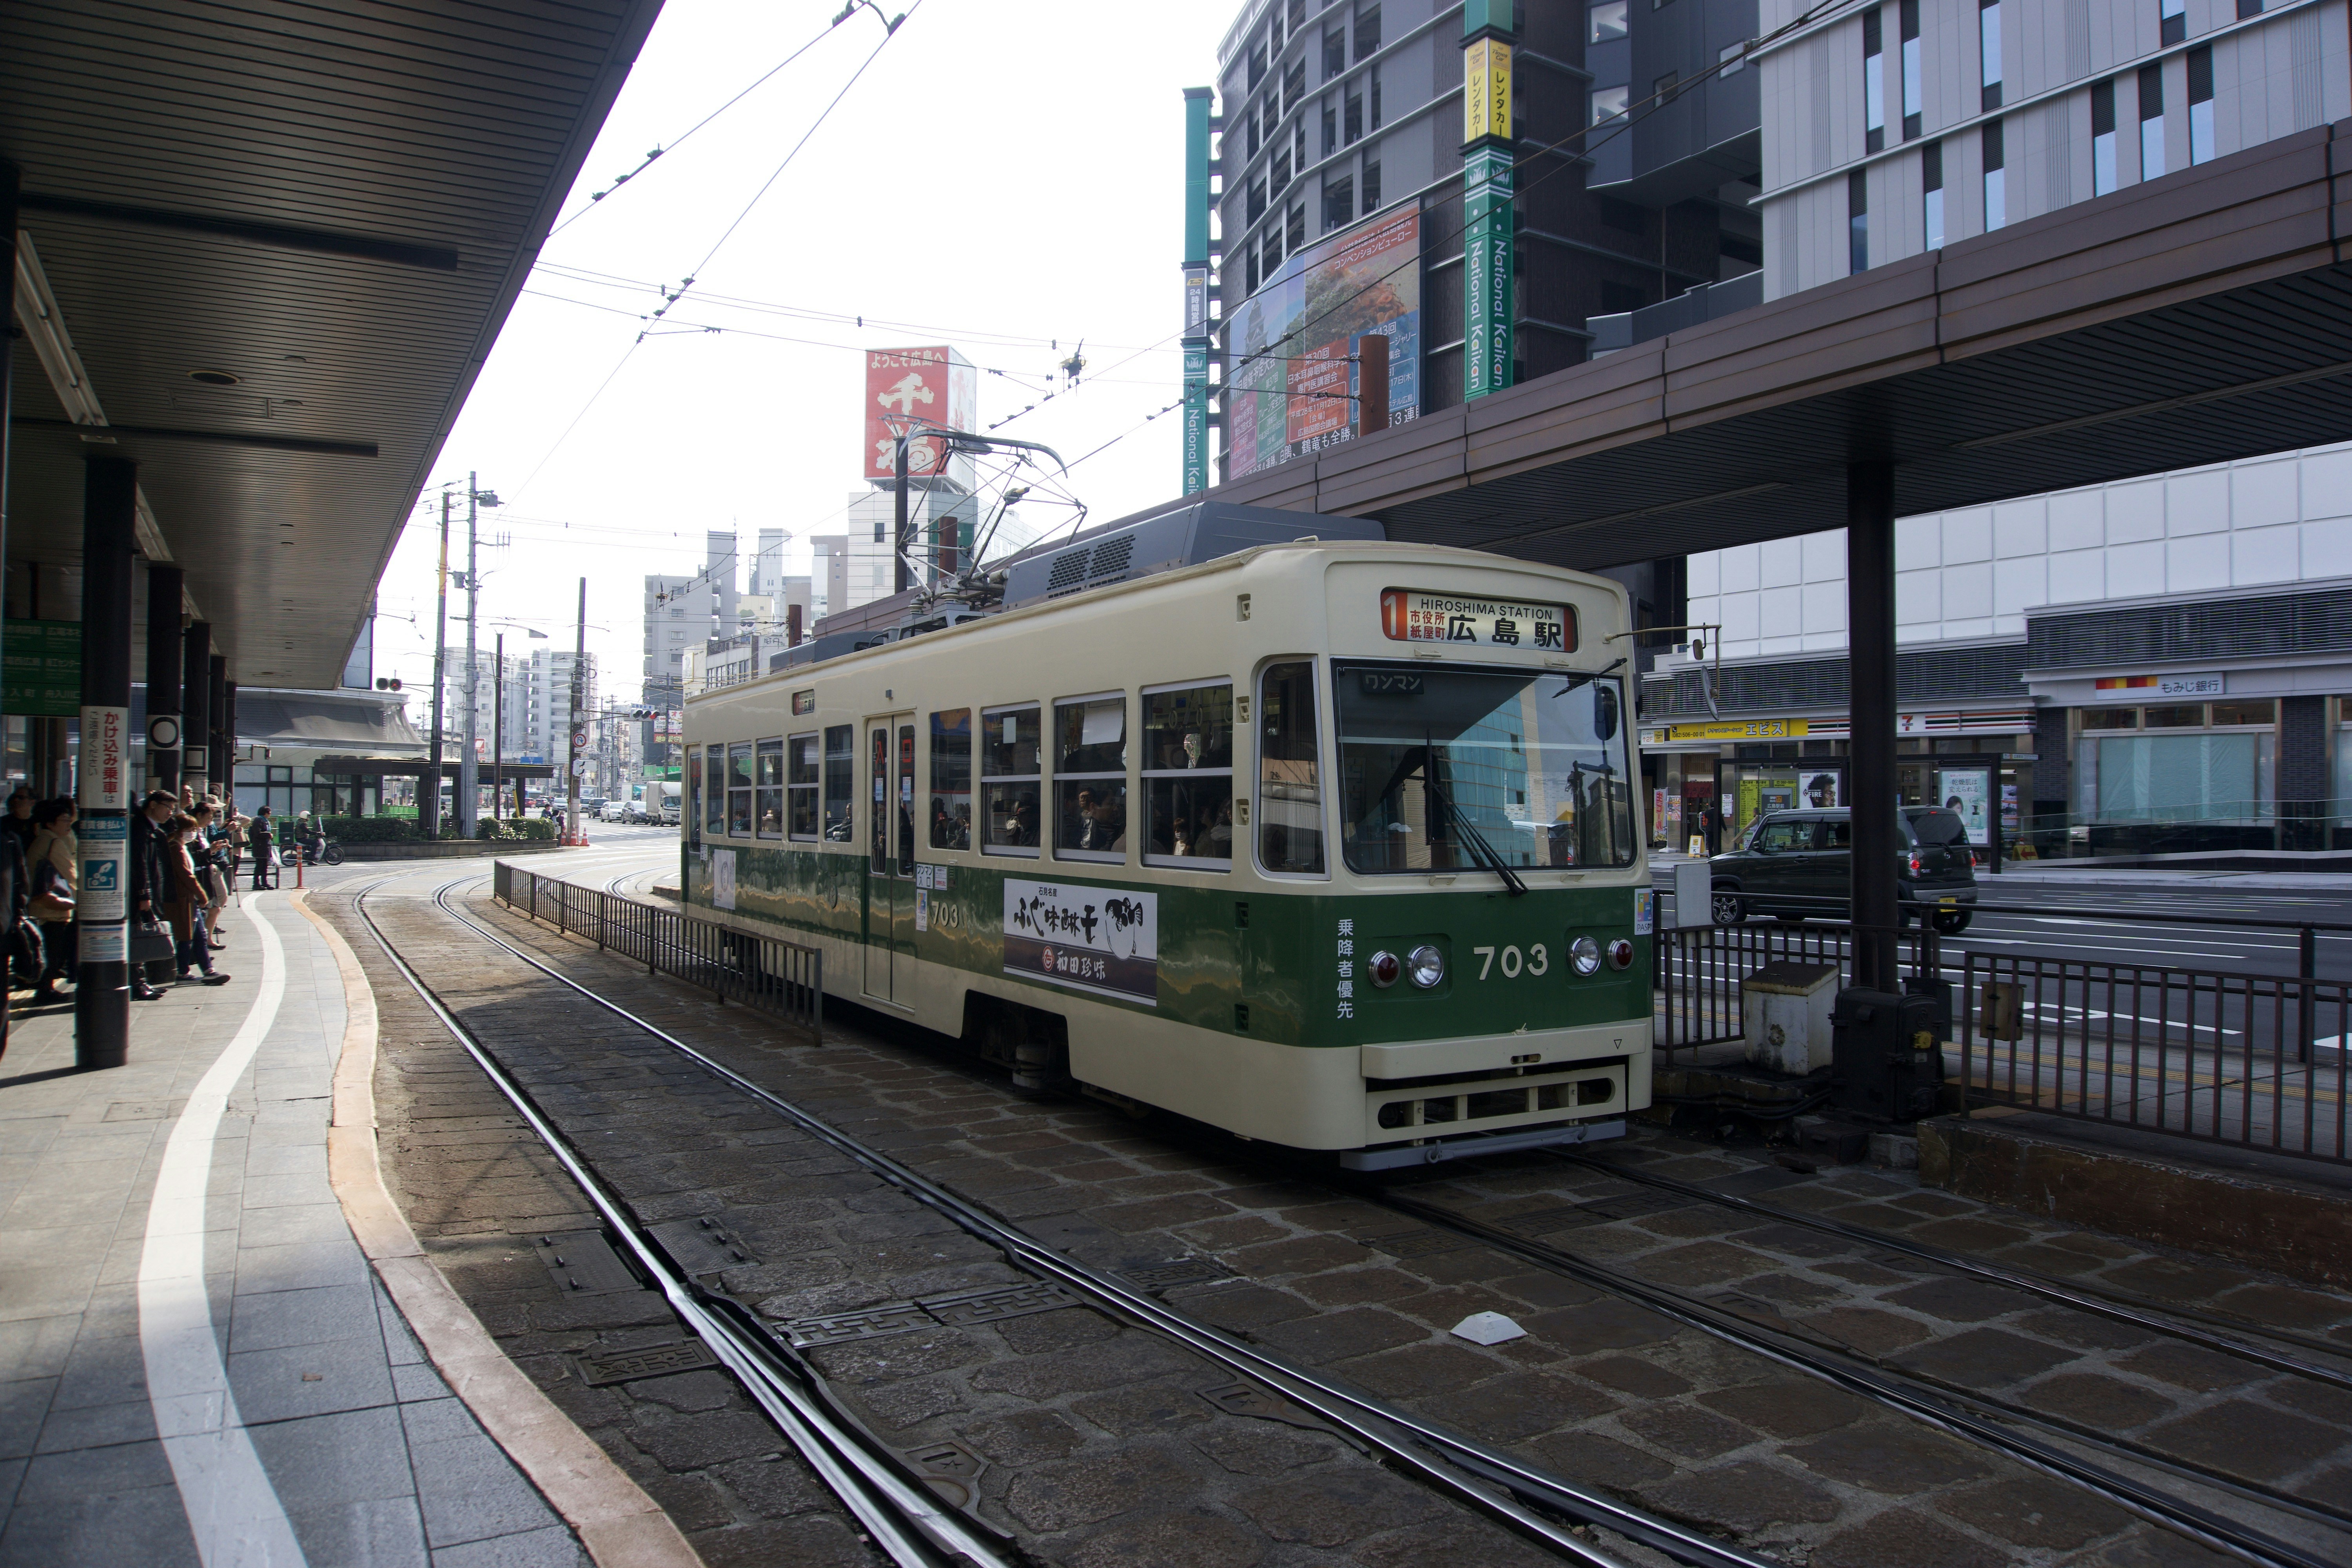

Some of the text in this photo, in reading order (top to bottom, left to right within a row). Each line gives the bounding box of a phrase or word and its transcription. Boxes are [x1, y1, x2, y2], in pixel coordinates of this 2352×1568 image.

[1473, 75, 1481, 137] レンタカー
[1496, 71, 1505, 136] レンタカー
[1335, 231, 1412, 270] コンベンションビューロー
[1471, 240, 1483, 389] National Kaikan
[1494, 240, 1506, 386] National Kaikan
[871, 350, 945, 369] ようこそ広島へ
[1305, 347, 1330, 366] 第30回
[1266, 372, 1278, 390] 第37回
[1288, 354, 1348, 385] 日本耳鼻咽喉科学会
[1297, 371, 1338, 393] 専門医講習会
[1290, 397, 1345, 419] 平成28年11月12日(土)
[1189, 409, 1200, 463] National
[1298, 417, 1338, 437] 広島国際会議場
[1280, 426, 1355, 463] 白鵬、鶴竜も全勝。
[1384, 595, 1396, 636] 1
[1410, 610, 1445, 625] 市役所
[1421, 598, 1552, 620] HIROSHIMA STATION
[1410, 625, 1445, 641] 紙屋町
[1446, 614, 1562, 648] 広島駅
[1365, 674, 1421, 690] ワンマン
[2161, 679, 2220, 693] もみじ銀行
[1746, 722, 1783, 735] エビス
[88, 711, 99, 776] ご遠慮ください
[875, 739, 911, 764] 入 口
[102, 711, 119, 804] かけ込み乗車は
[917, 866, 933, 876] ワンマン
[919, 877, 931, 887] 入口
[1038, 887, 1058, 897] 石見名産
[931, 901, 958, 928] 703
[1637, 923, 1652, 931] PASPY
[1056, 951, 1106, 980] 和田珍味
[1337, 918, 1354, 1019] 乗降者優先
[1474, 943, 1548, 981] 703
